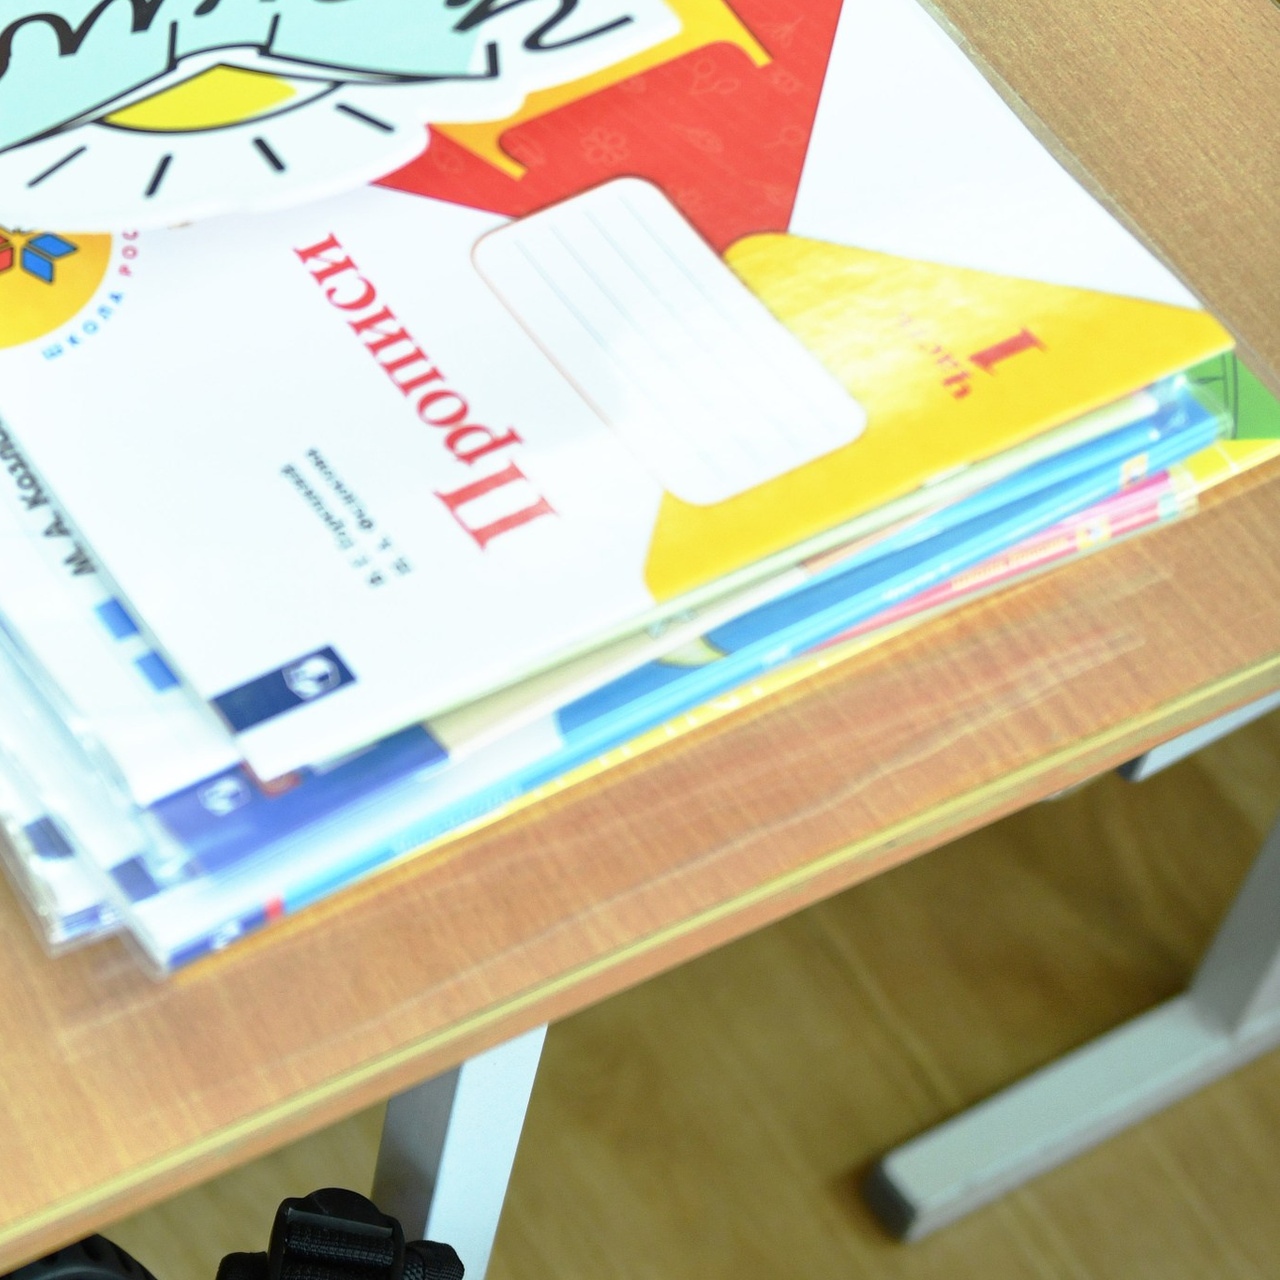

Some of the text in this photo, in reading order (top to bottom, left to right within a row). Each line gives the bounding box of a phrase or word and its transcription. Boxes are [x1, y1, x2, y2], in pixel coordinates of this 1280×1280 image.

[41, 229, 140, 360] ШКОЛА РОС
[968, 327, 1048, 376] 1
[293, 232, 558, 550] Прописи
